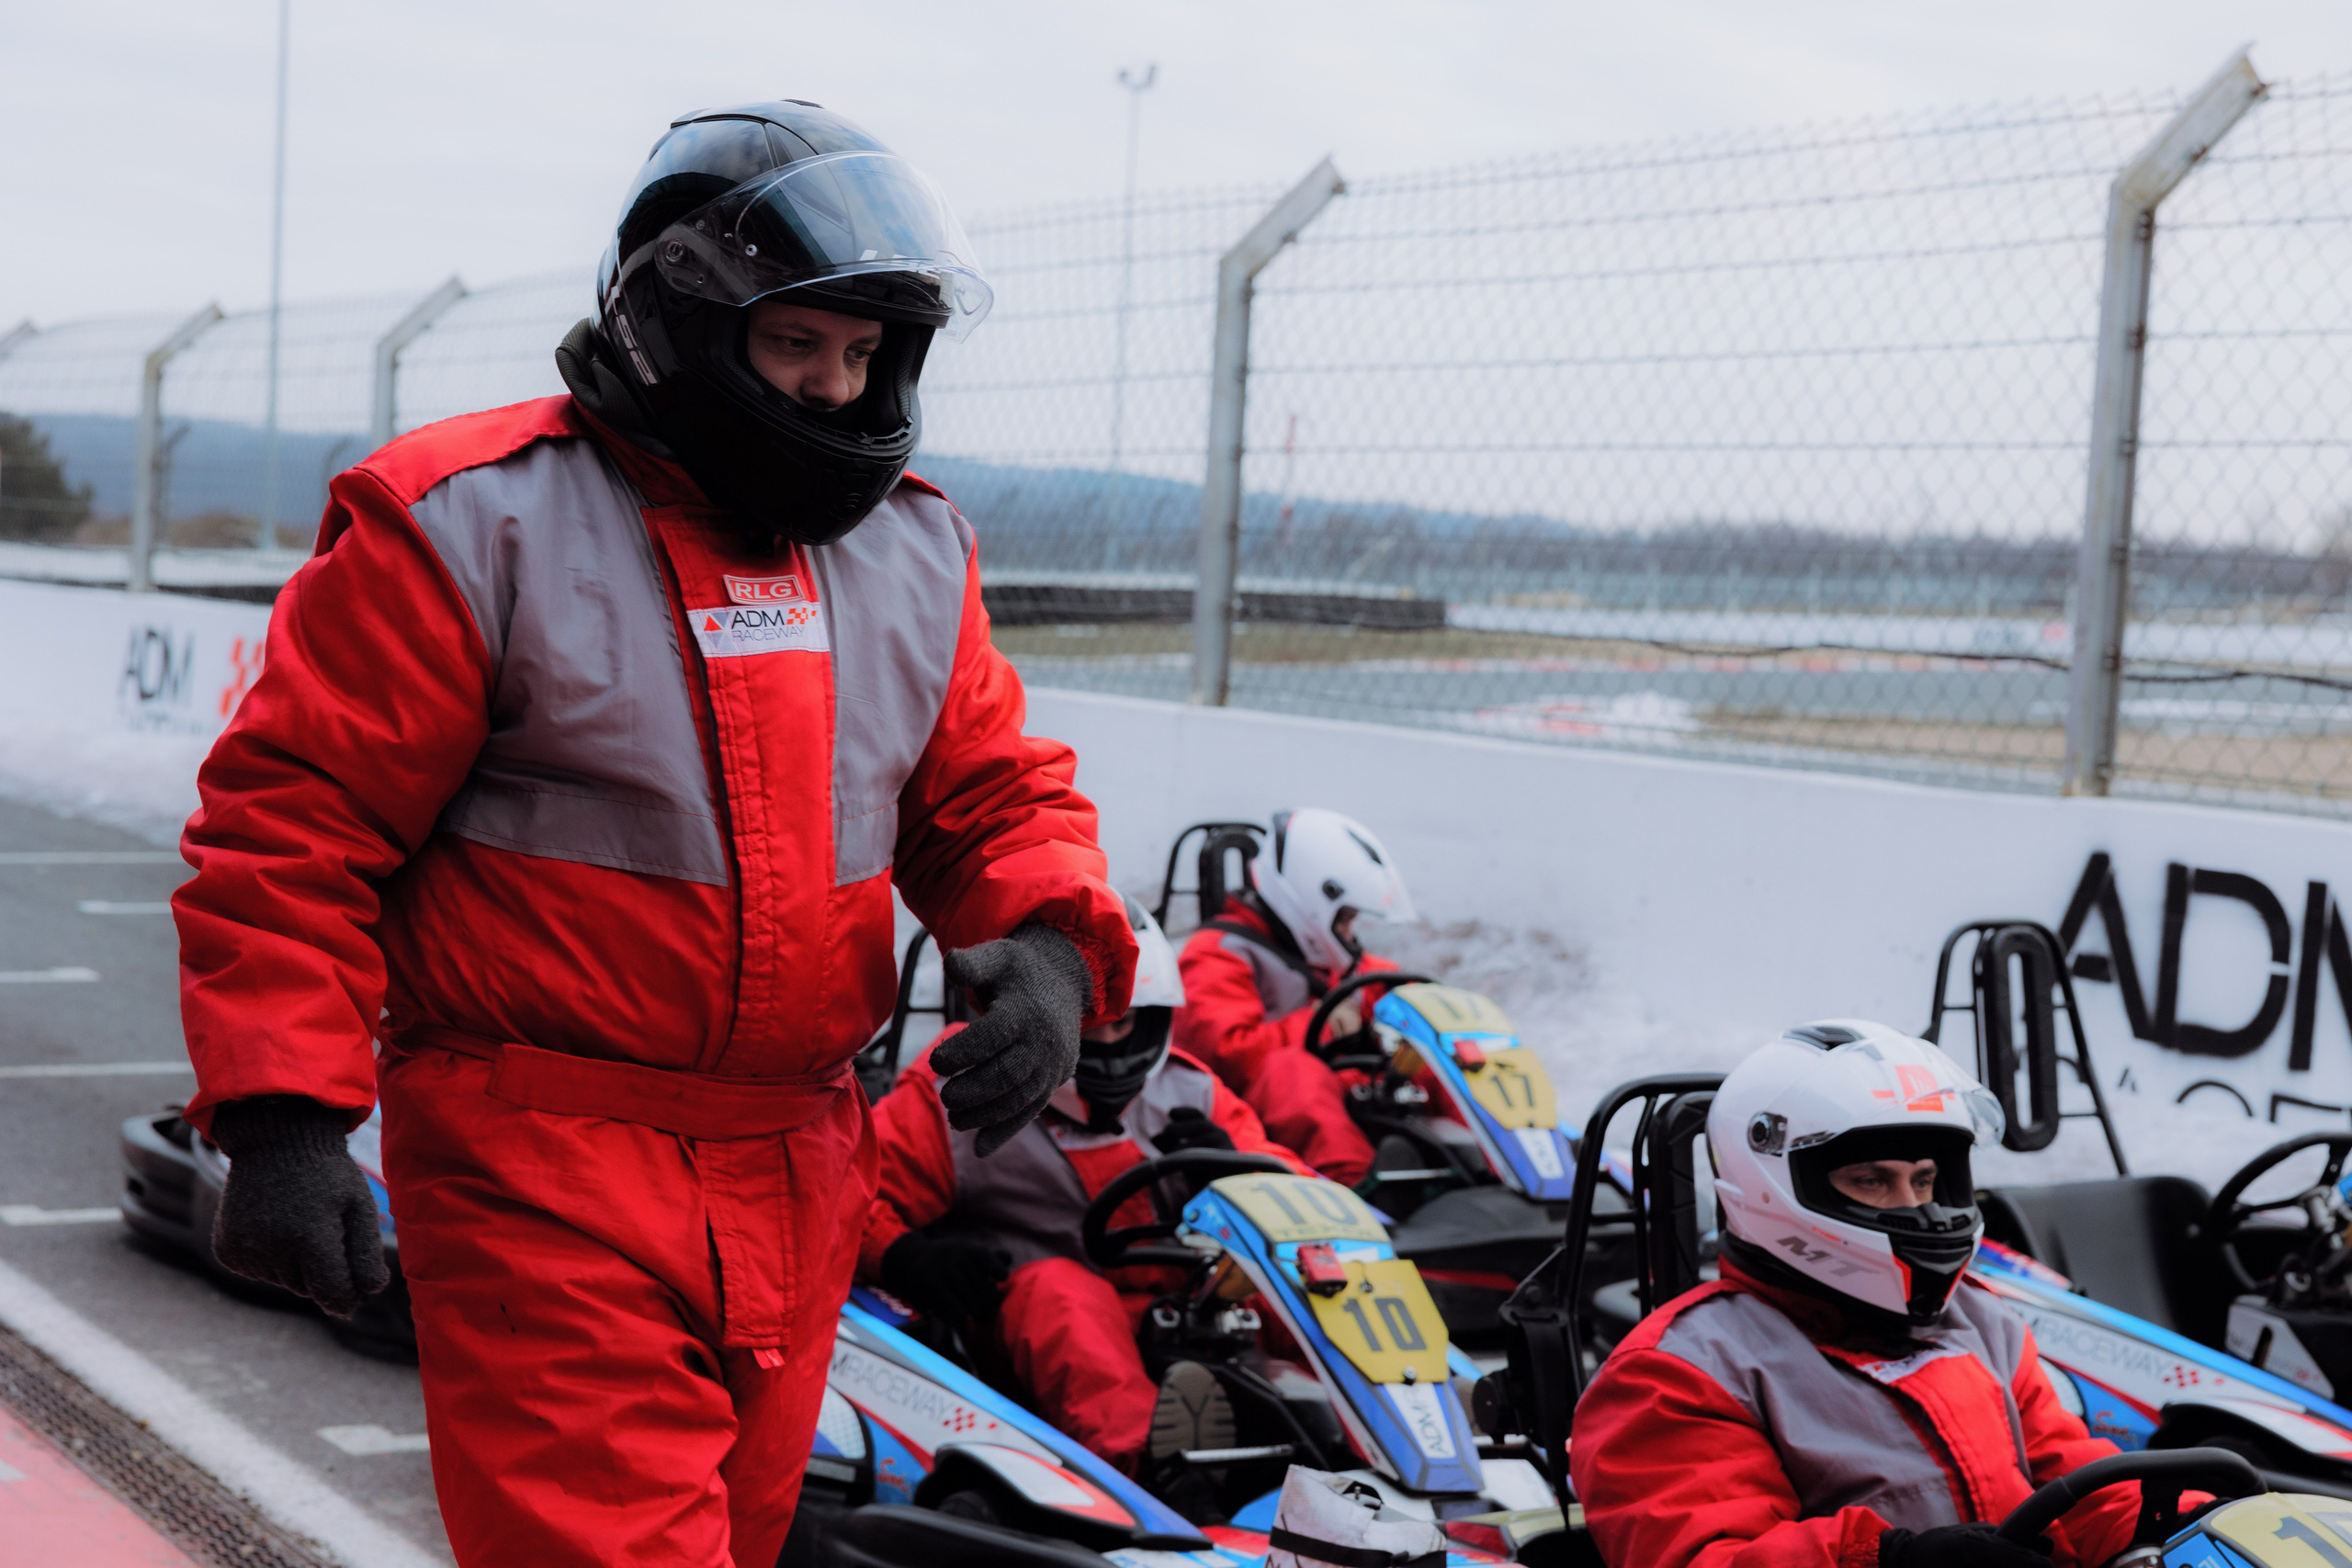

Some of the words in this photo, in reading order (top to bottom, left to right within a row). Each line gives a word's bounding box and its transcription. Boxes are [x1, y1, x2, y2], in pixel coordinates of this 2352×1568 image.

[735, 582, 792, 599] RLG
[730, 610, 786, 629] ADM
[731, 626, 806, 643] RACEWAY
[1250, 1181, 1359, 1225] 10
[1342, 1296, 1428, 1353] 10
